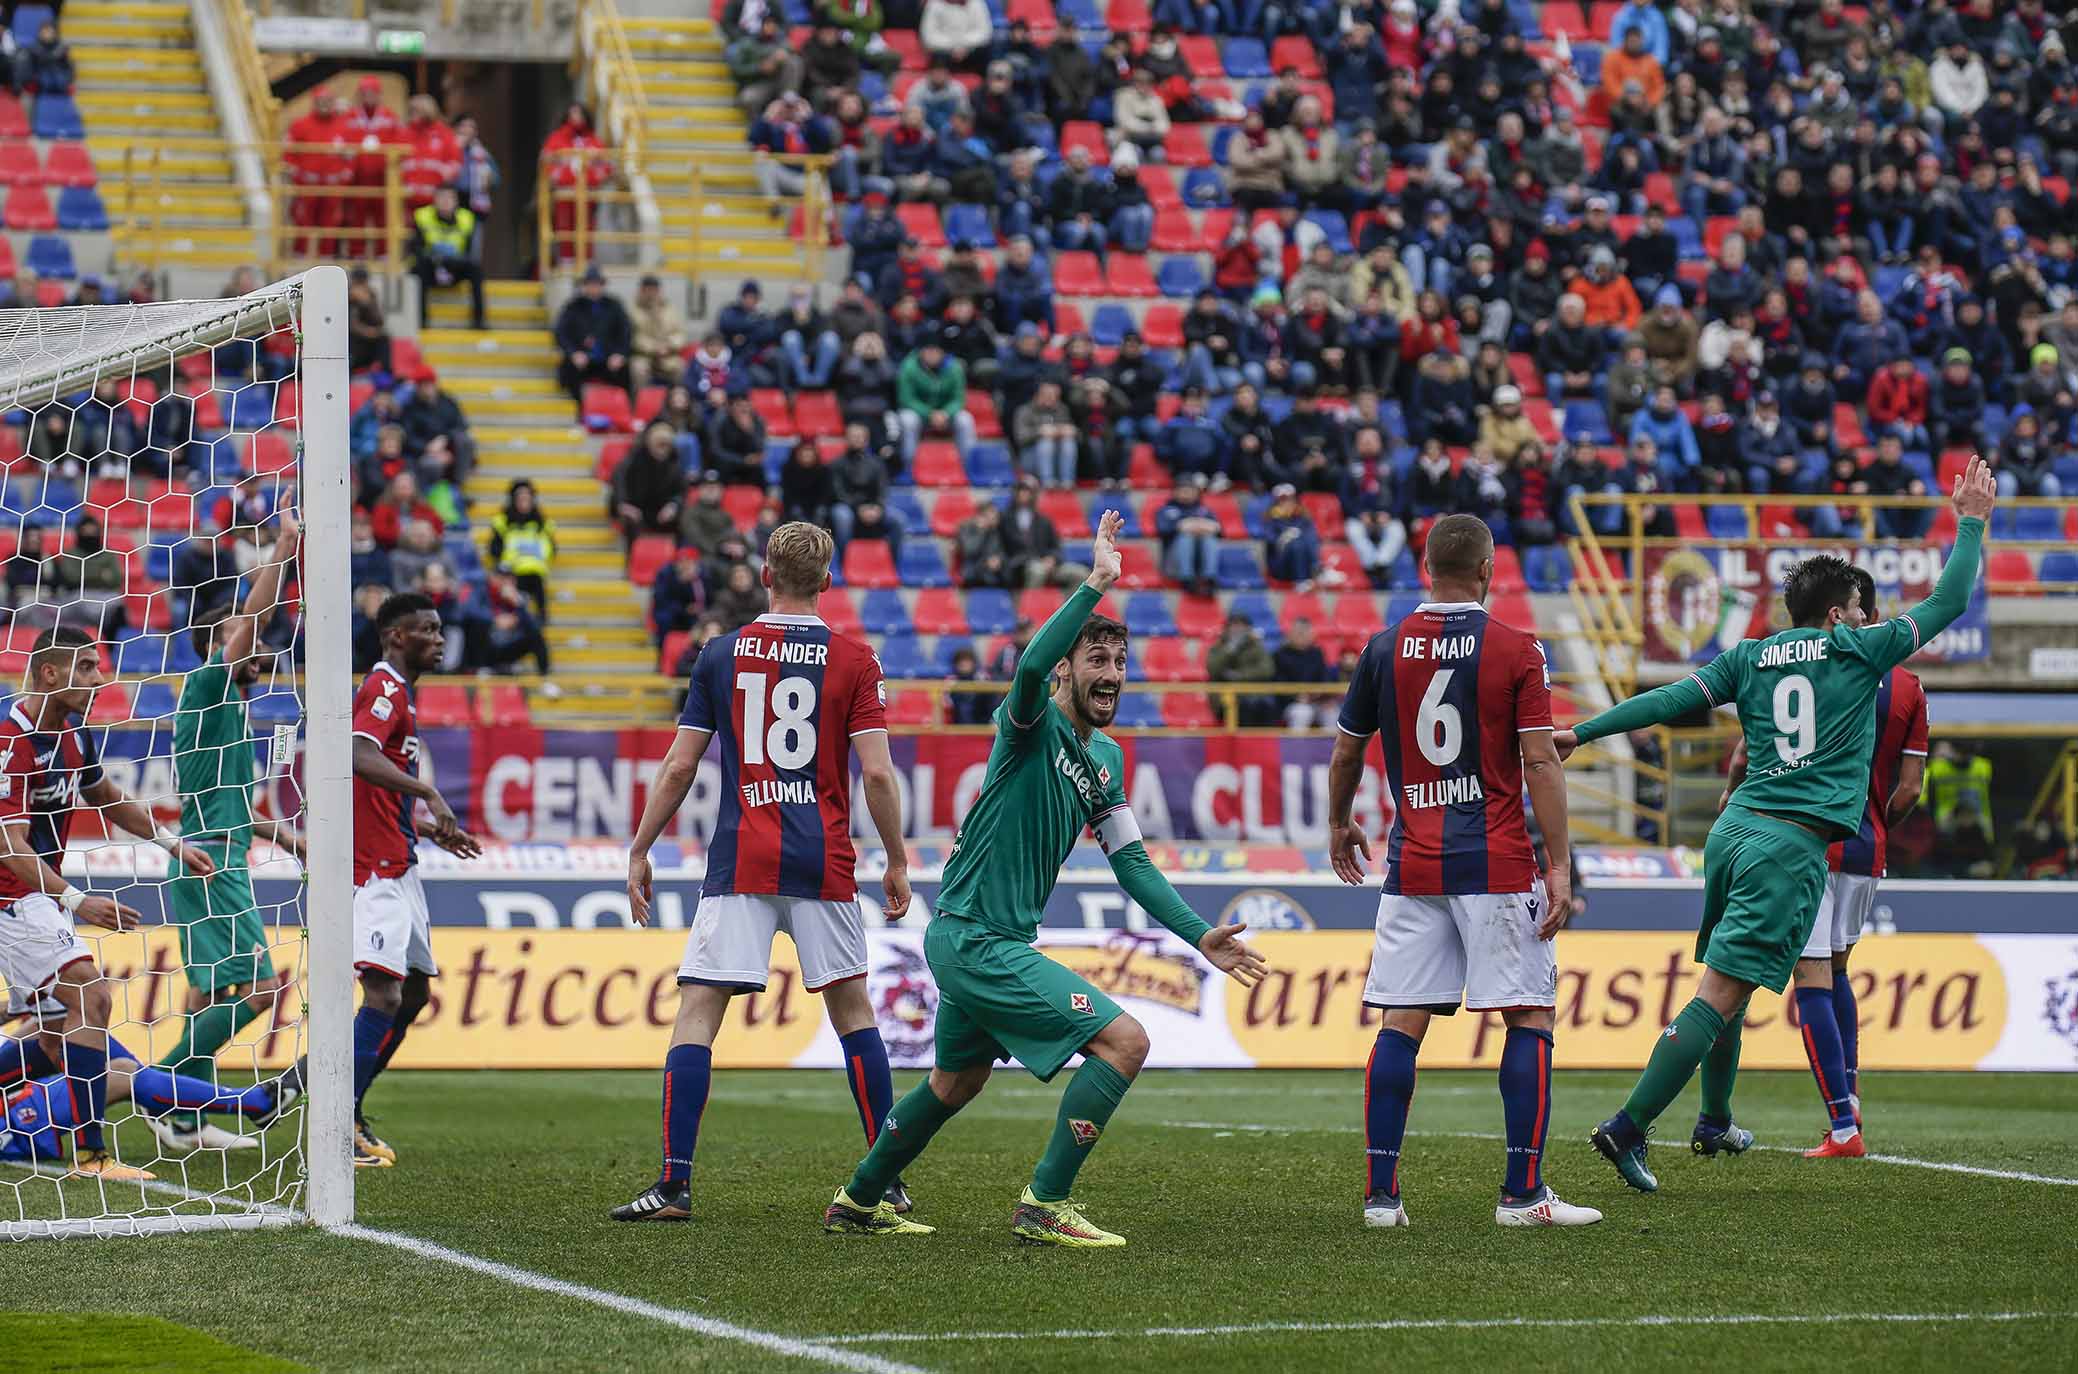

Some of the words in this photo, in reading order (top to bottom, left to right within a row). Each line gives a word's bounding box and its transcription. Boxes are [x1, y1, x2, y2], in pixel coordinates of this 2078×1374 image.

[1720, 549, 1759, 586] IL
[734, 637, 828, 665] HELANDER
[1402, 637, 1426, 659] DE
[1431, 635, 1475, 659] MAIO
[1758, 637, 1827, 668] SIMEONE
[736, 671, 817, 770] 18
[1416, 668, 1463, 766] 6
[1773, 674, 1816, 763] 9
